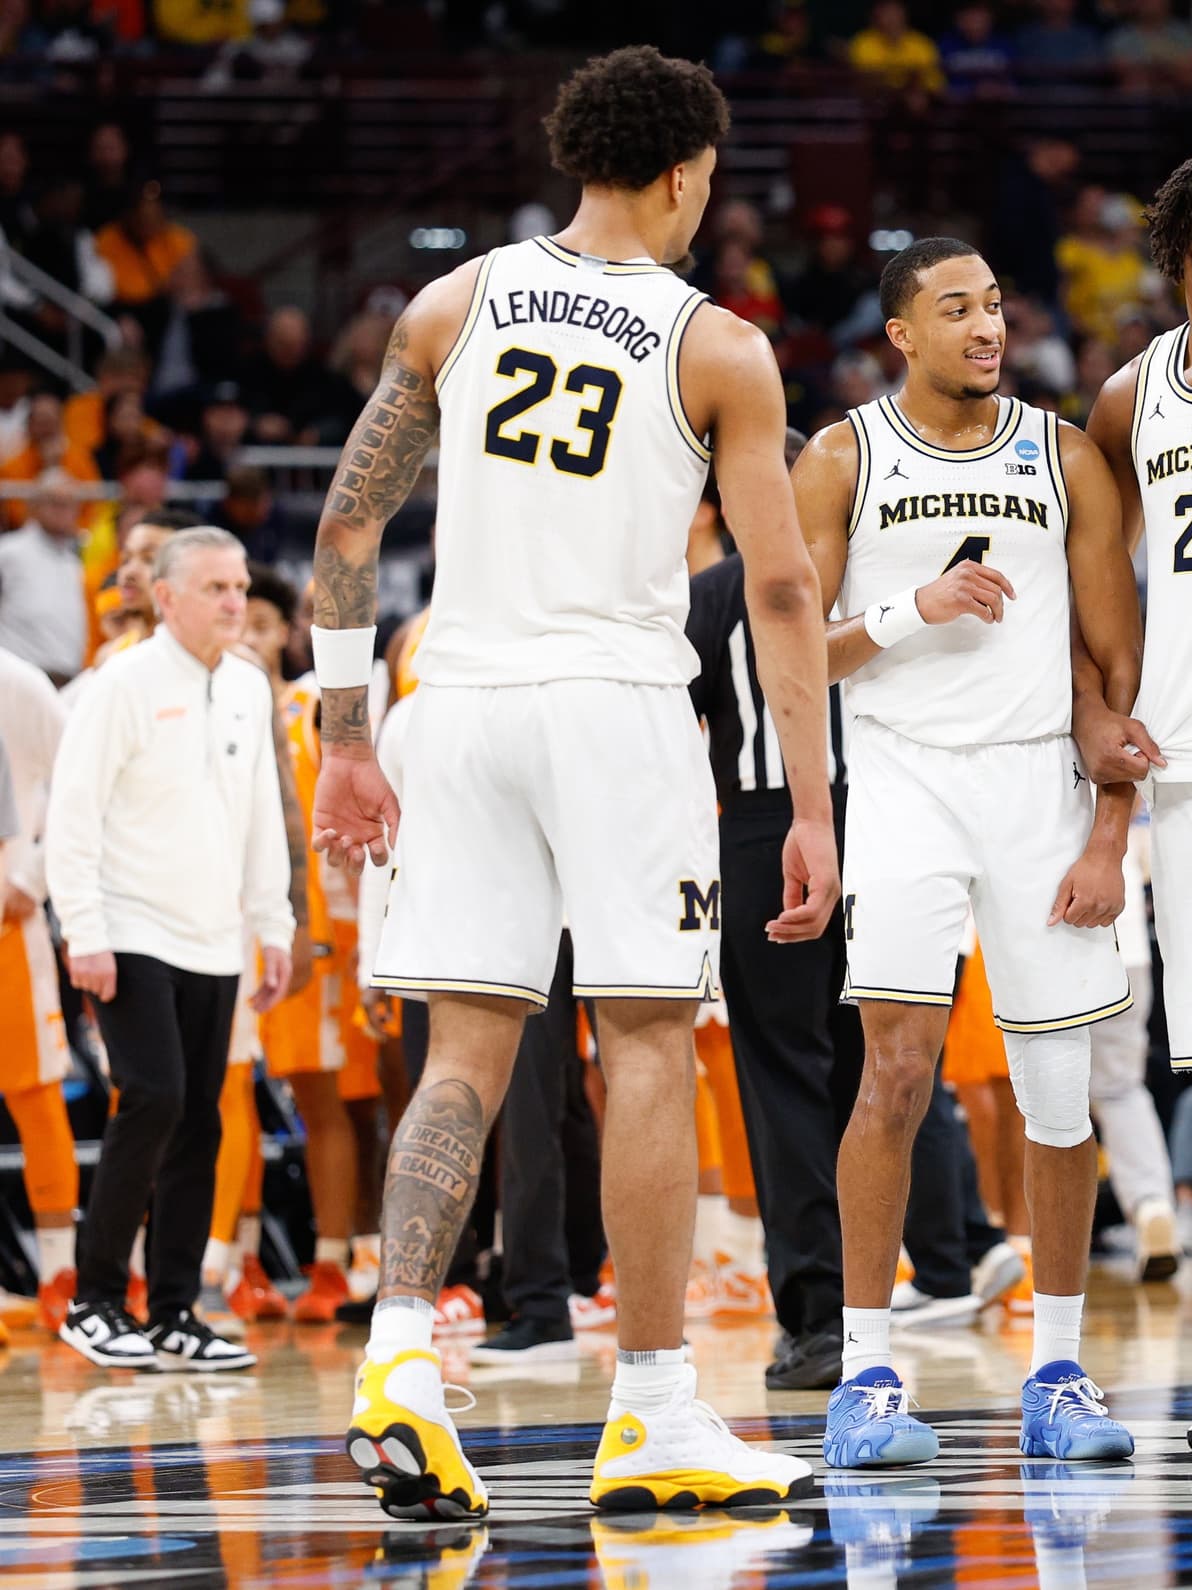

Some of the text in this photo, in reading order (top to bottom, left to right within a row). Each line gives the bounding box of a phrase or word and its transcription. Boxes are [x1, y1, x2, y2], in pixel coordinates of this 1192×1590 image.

[489, 290, 661, 363] LENDEBORG
[483, 346, 624, 480] 23
[879, 493, 1049, 530] MICHIGAN
[678, 880, 720, 931] M
[409, 1126, 474, 1170] DREAMS
[399, 1155, 463, 1191] REALITY
